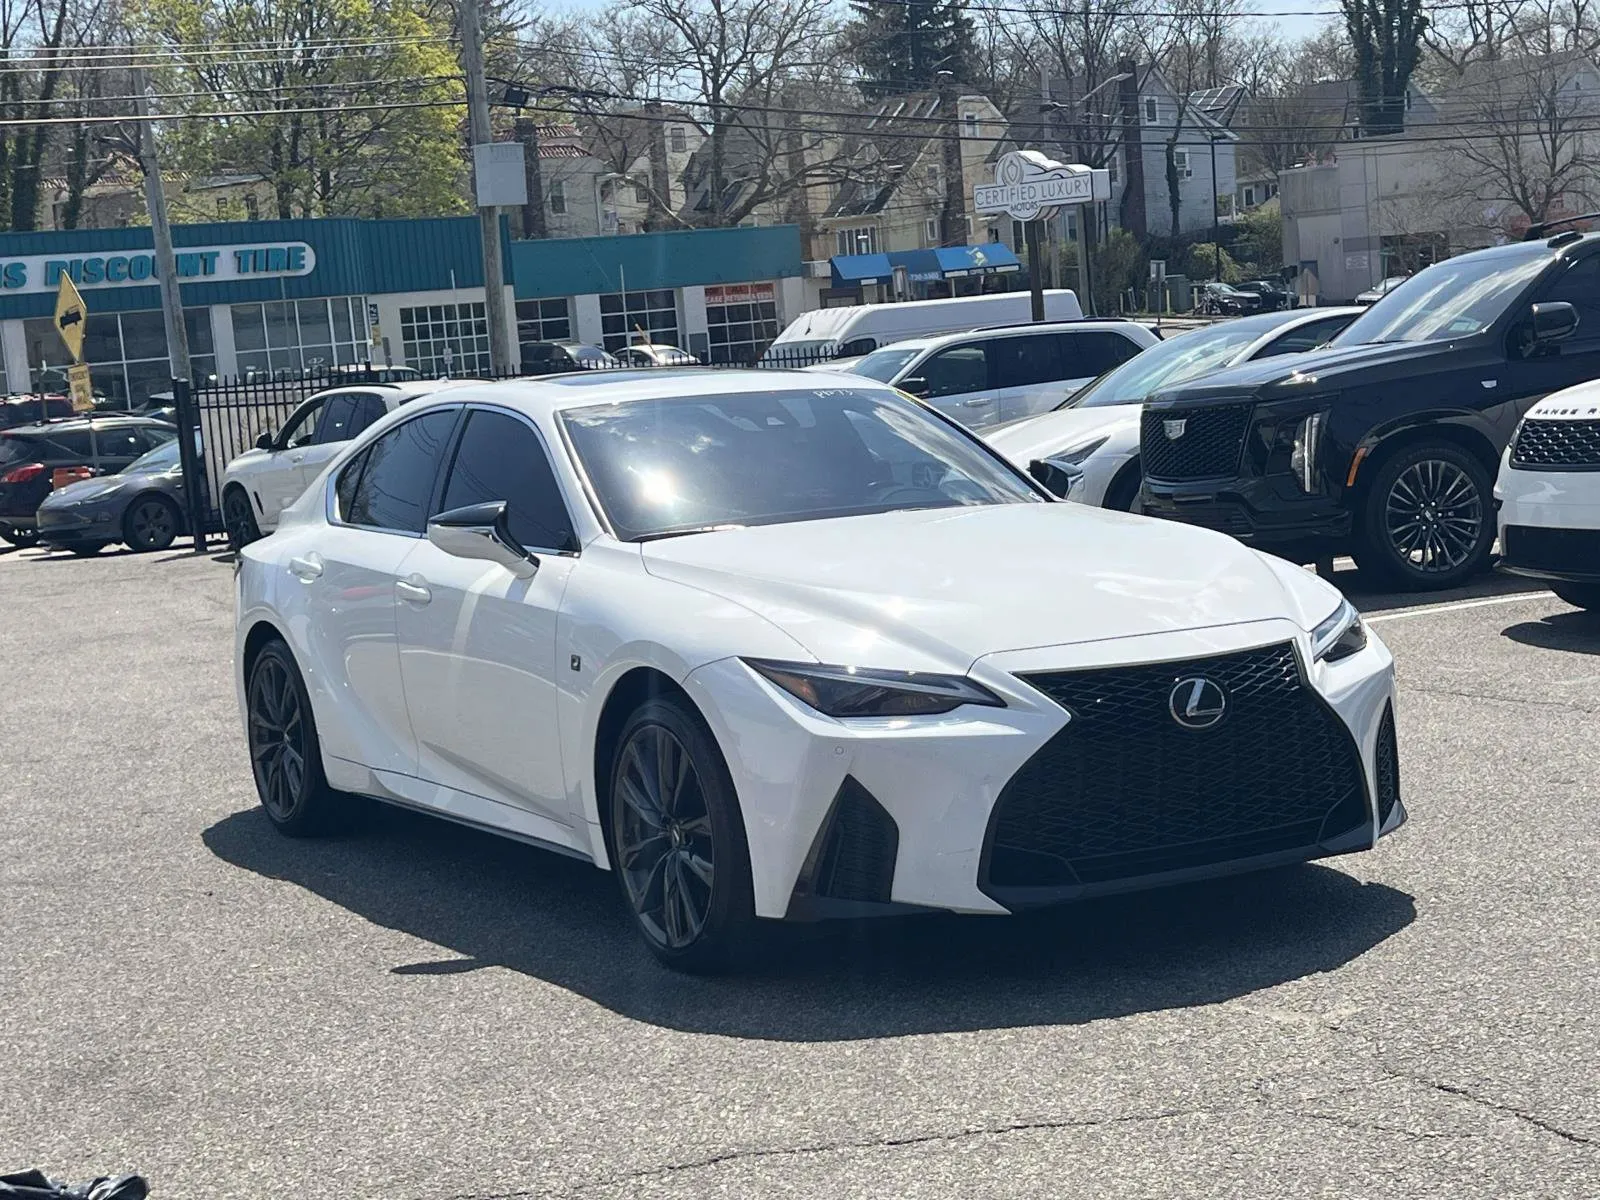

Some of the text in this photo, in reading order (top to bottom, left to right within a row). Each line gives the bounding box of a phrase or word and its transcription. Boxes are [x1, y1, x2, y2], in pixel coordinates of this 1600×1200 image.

[975, 179, 1089, 206] CERTIFIED LUXURY
[0, 262, 27, 289] S
[234, 246, 306, 274] TIRE
